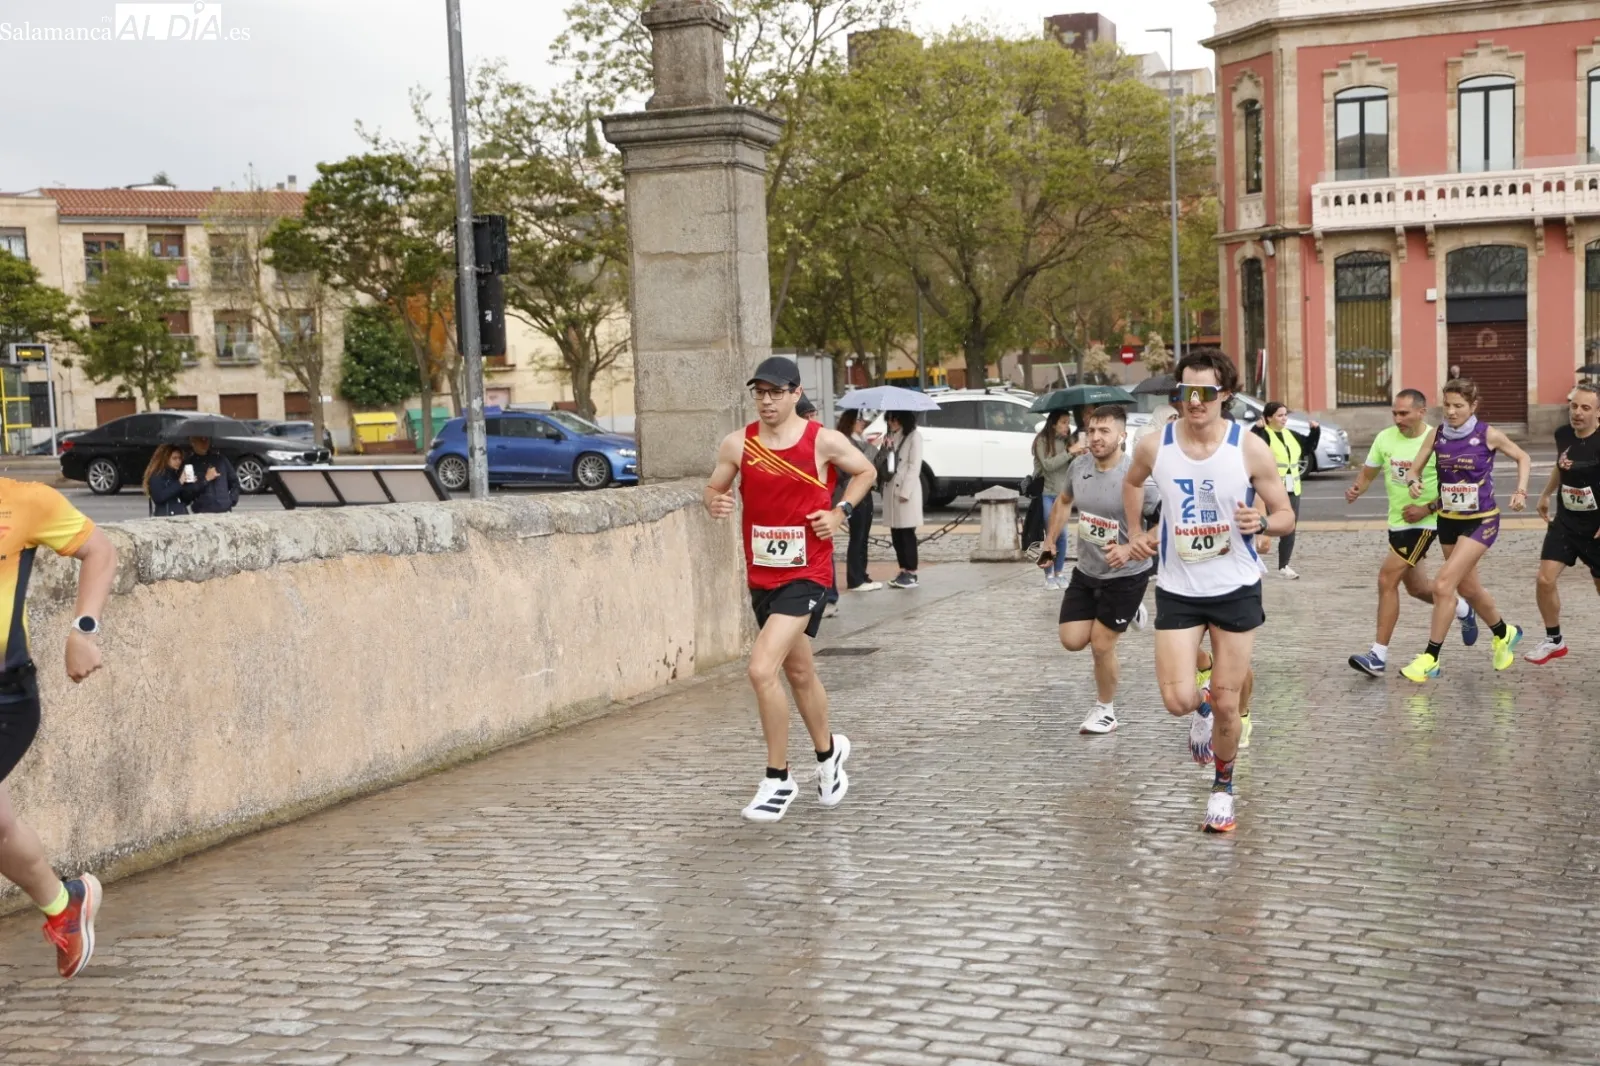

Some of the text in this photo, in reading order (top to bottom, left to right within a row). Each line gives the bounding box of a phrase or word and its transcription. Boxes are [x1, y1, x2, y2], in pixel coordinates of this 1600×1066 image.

[1398, 467, 1411, 477] 5
[1200, 480, 1214, 491] 5
[1451, 492, 1465, 503] 21
[1570, 494, 1584, 504] 94
[753, 528, 804, 539] bedunia
[1090, 525, 1106, 538] 28
[1175, 525, 1230, 536] bedunia
[766, 540, 788, 555] 49
[1191, 535, 1214, 551] 40
